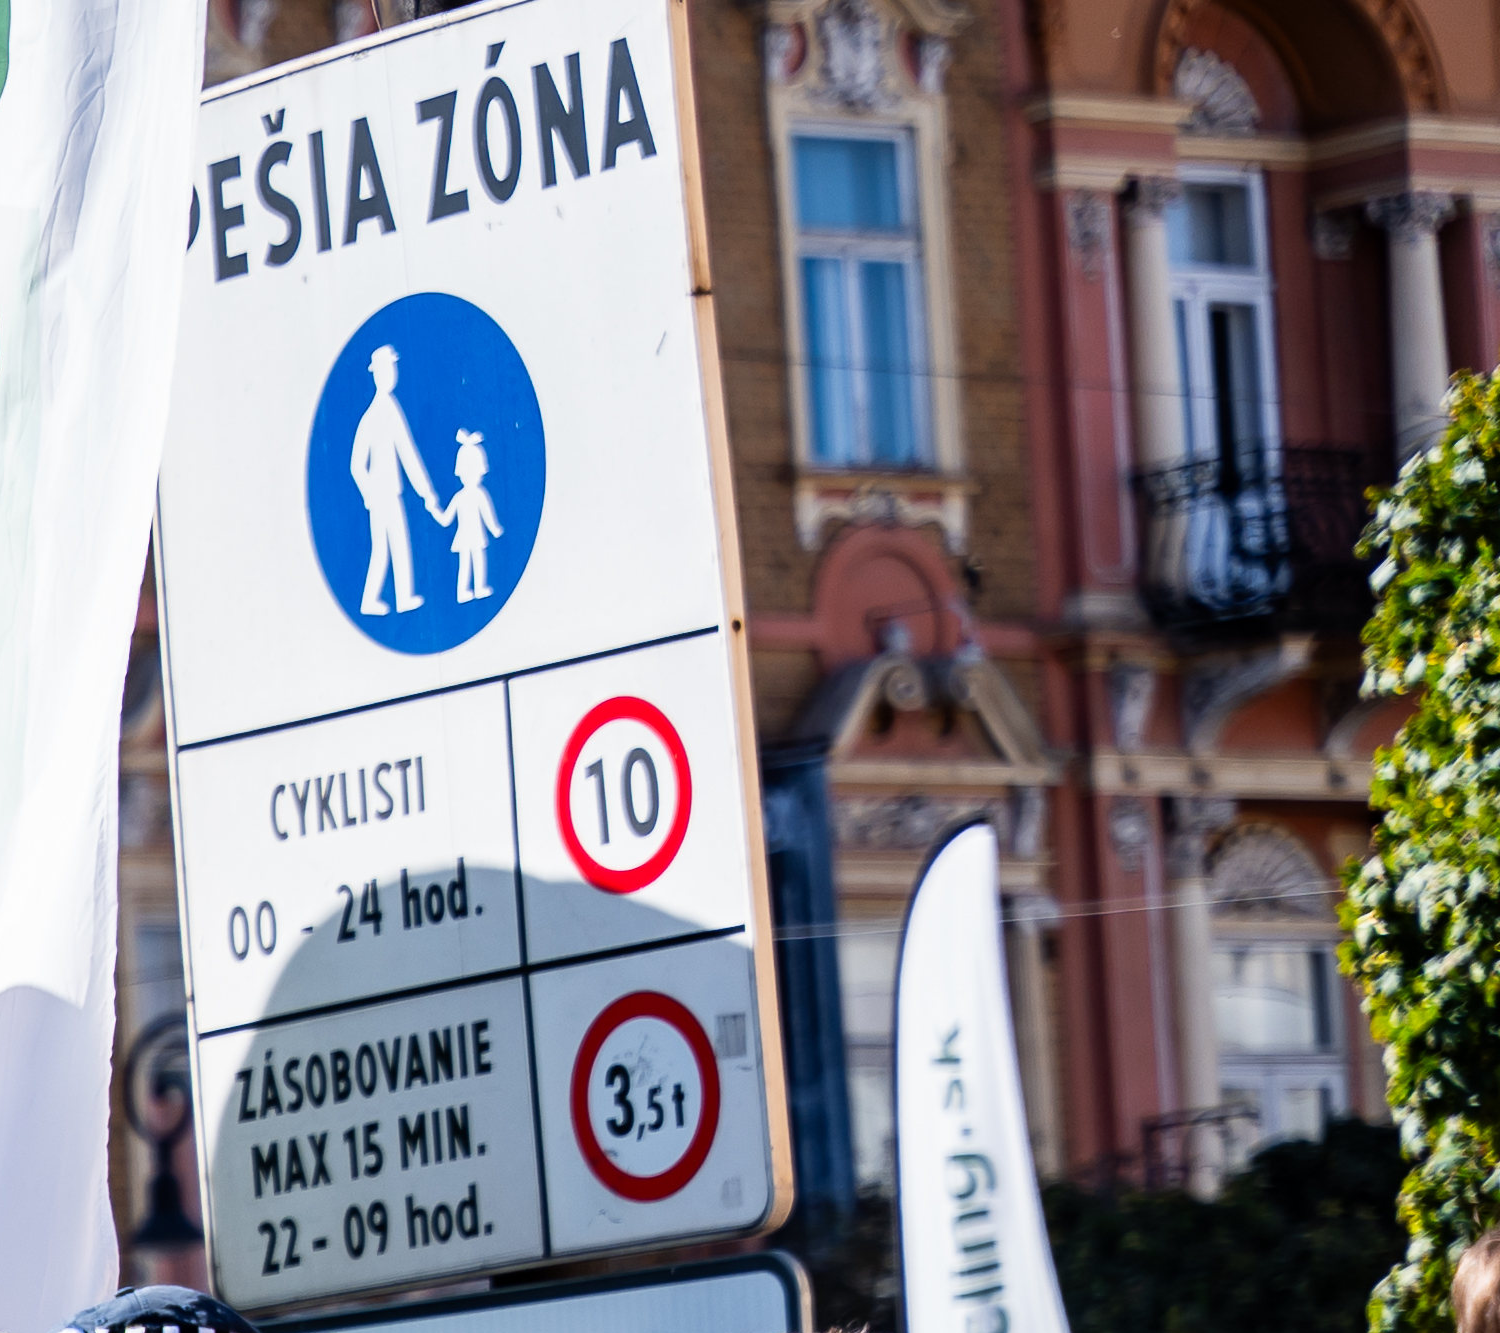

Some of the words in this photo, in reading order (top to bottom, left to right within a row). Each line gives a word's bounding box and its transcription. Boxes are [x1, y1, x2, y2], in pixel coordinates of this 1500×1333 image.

[185, 107, 397, 284] EŠIA
[415, 37, 658, 225] ZÓNA
[270, 755, 427, 842] CYKLISTI
[584, 747, 660, 846] 10
[228, 900, 278, 961] 00
[336, 878, 383, 944] 24
[400, 856, 484, 932] hod.
[235, 1018, 494, 1126] ZÁSOBOVANIE
[249, 1126, 331, 1200] MAX
[342, 1120, 383, 1181] 15
[400, 1104, 487, 1171] MIN.
[257, 1215, 304, 1277] 22
[342, 1201, 390, 1260] 09
[405, 1184, 494, 1252] hod.
